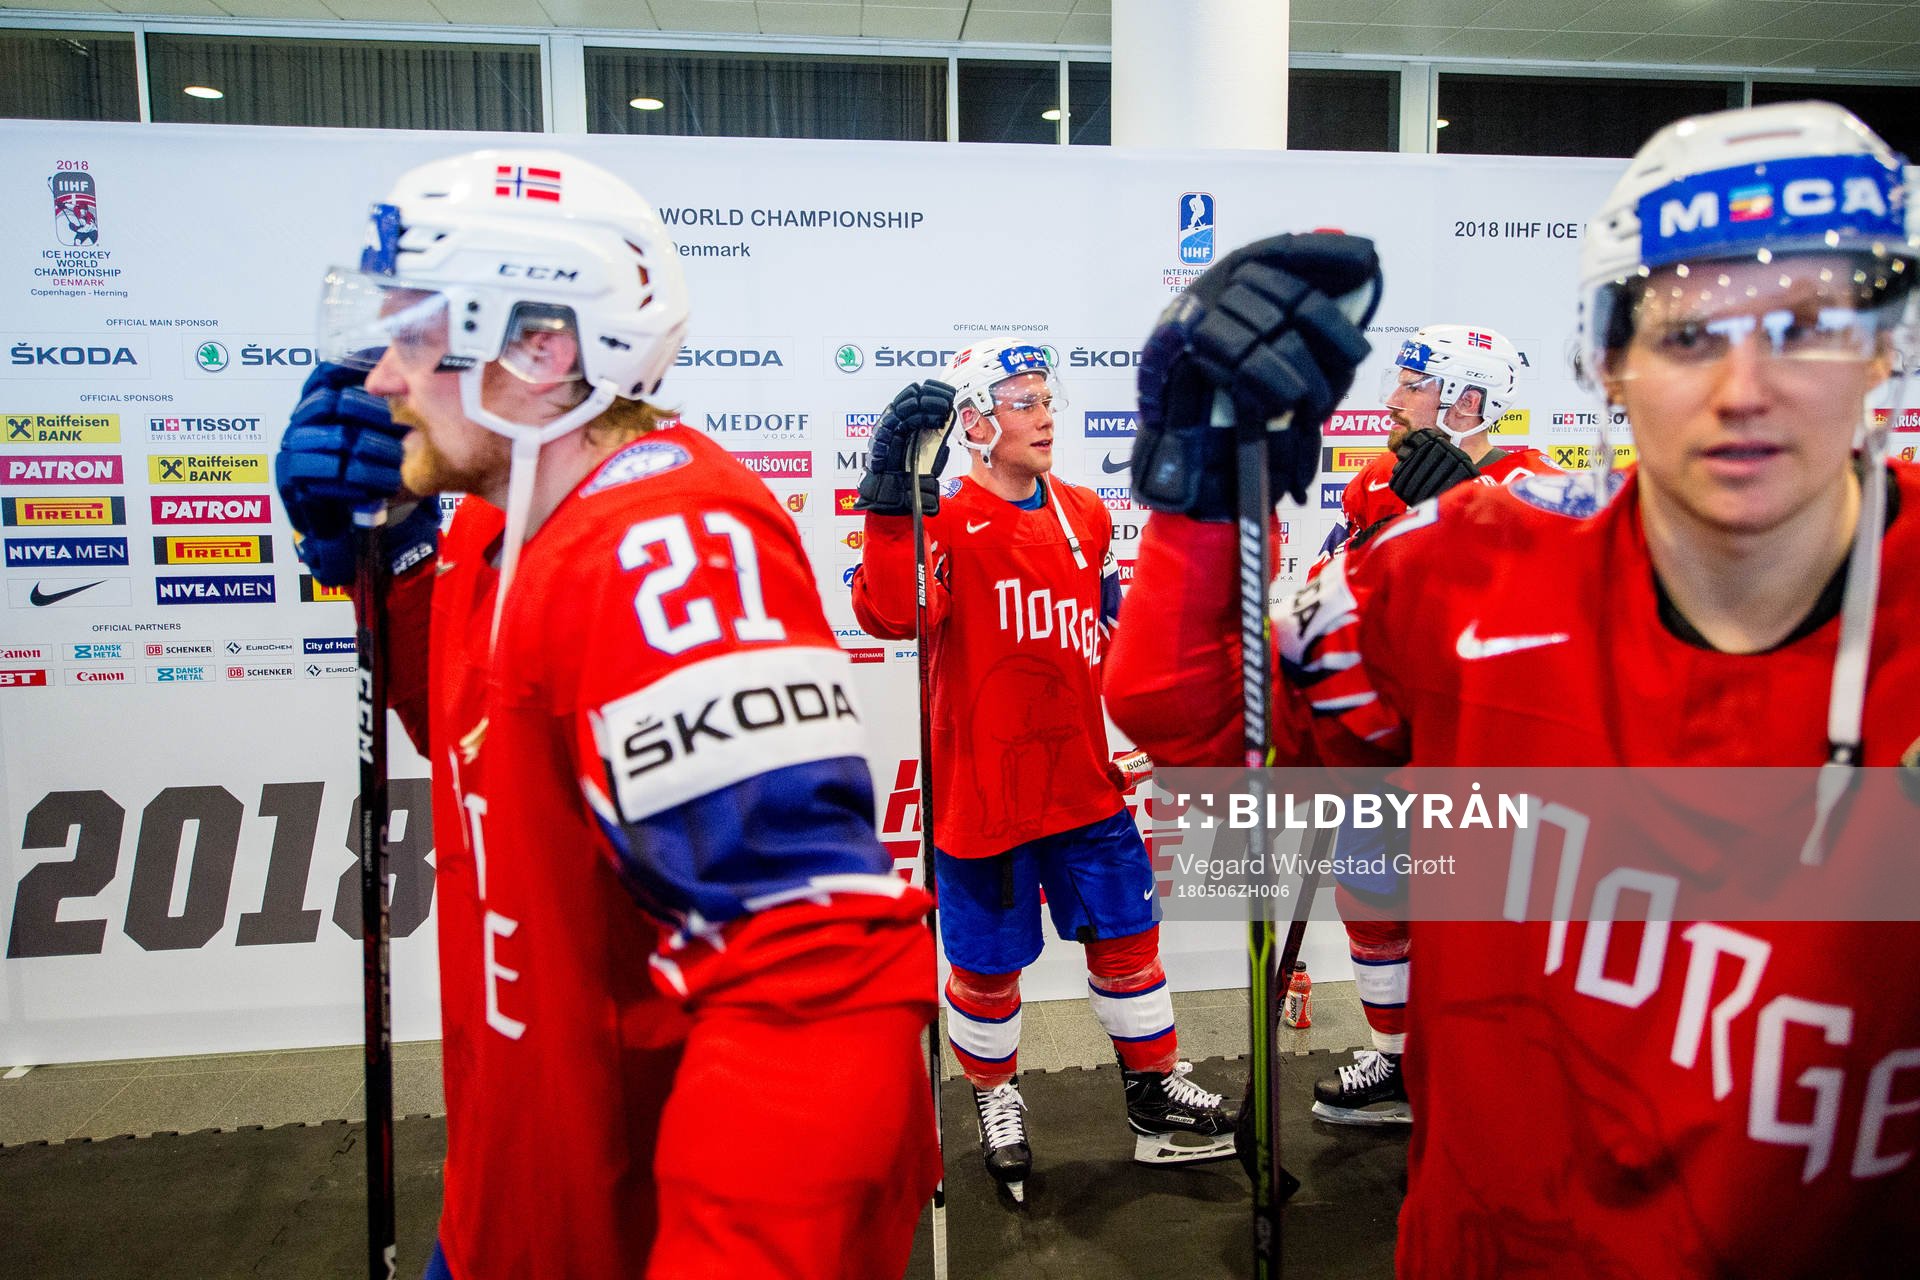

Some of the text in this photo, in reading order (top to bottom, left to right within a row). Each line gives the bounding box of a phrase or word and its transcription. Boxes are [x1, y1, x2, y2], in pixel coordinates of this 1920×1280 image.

[56, 160, 89, 170] 2018
[59, 180, 89, 192] IIHF
[659, 207, 925, 229] WORLD CHAMPIONSHIP
[1454, 222, 1499, 238] 2018
[1504, 223, 1541, 238] IIHF
[1546, 223, 1577, 239] ICE
[42, 250, 111, 260] ICE HOCKEY
[1183, 247, 1210, 258] IIHF
[56, 260, 98, 268] WORLD
[34, 268, 122, 278] CHAMPIONSHIP
[498, 263, 579, 282] CCM
[52, 278, 105, 287] DENMARK
[1163, 276, 1181, 285] ICE
[30, 288, 86, 298] Copenhagen
[93, 289, 129, 299] Herning
[106, 319, 219, 327] OFFICIAL MAIN SPONSOR
[1011, 324, 1049, 332] SPONSOR
[10, 342, 138, 366] ŠKODA
[241, 344, 319, 366] ŠKO
[674, 346, 783, 367] ŠKODA
[874, 347, 957, 367] ŠKOD
[80, 394, 174, 402] OFFICIAL SPONSORS
[36, 415, 110, 428] Raiffeisen
[181, 418, 260, 431] TISSOT
[706, 413, 809, 431] MEDOFF
[846, 414, 881, 425] LIQU
[1088, 418, 1138, 431] NIVEA
[1330, 414, 1395, 433] PATRO
[38, 430, 83, 441] BANK
[847, 426, 873, 437] MOL
[188, 456, 259, 468] Raiffeisen
[9, 460, 114, 480] PATRON
[189, 471, 232, 482] BANK
[1097, 489, 1131, 499] LIQUI
[24, 503, 104, 520] PIRELLI
[160, 501, 262, 520] PATRON
[9, 544, 125, 560] NIVEA MEN
[175, 541, 252, 558] PIRELLI
[616, 510, 787, 656] 21
[160, 582, 272, 598] NIVEA MEN
[92, 623, 182, 632] OFFICIAL PARTNERS
[147, 644, 213, 655] DB SCHENKER
[305, 641, 356, 651] City of Hern
[76, 672, 125, 681] Canon
[176, 673, 204, 681] METAL
[229, 668, 293, 676] DB SCHENKER
[623, 682, 860, 779] ŠKODA
[6, 777, 438, 959] 2018
